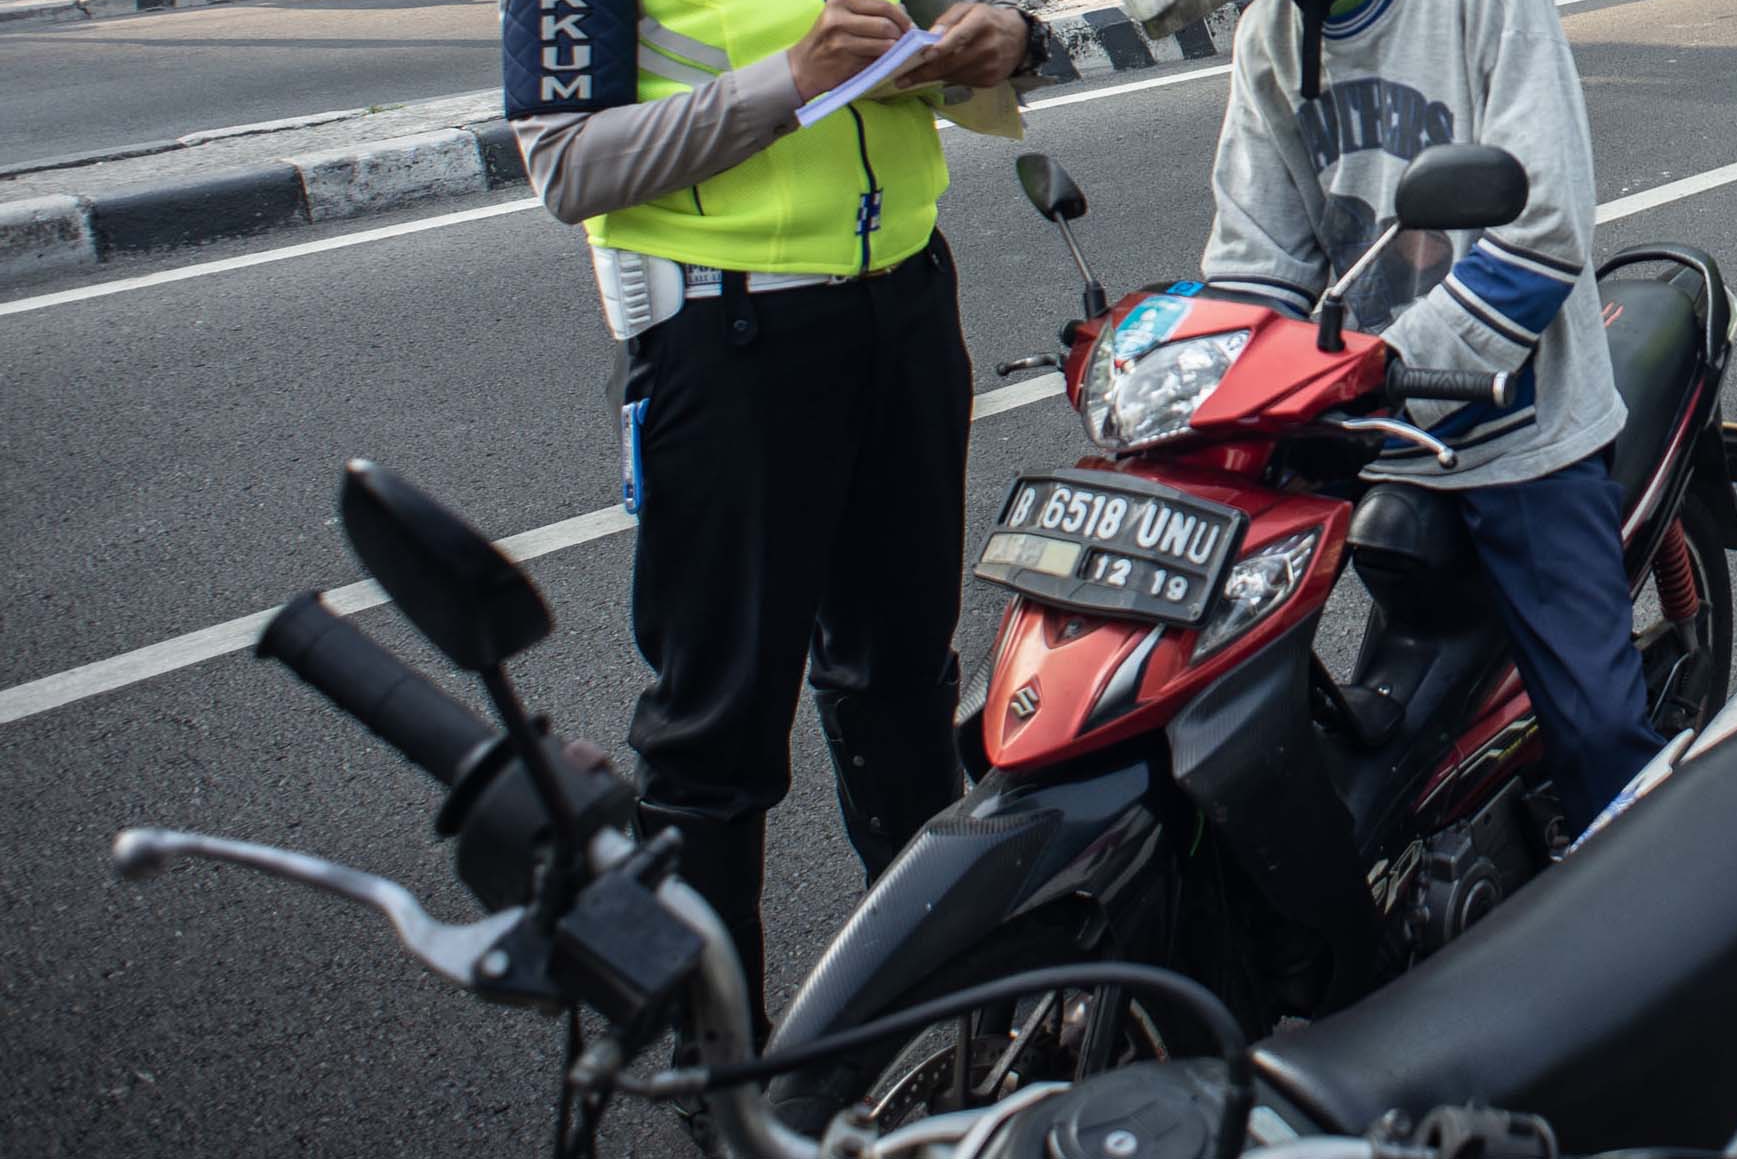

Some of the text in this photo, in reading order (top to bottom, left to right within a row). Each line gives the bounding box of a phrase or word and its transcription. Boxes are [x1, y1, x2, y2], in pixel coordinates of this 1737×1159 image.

[1009, 487, 1219, 565] B 6518 UNU
[1094, 554, 1189, 601] 12 19
